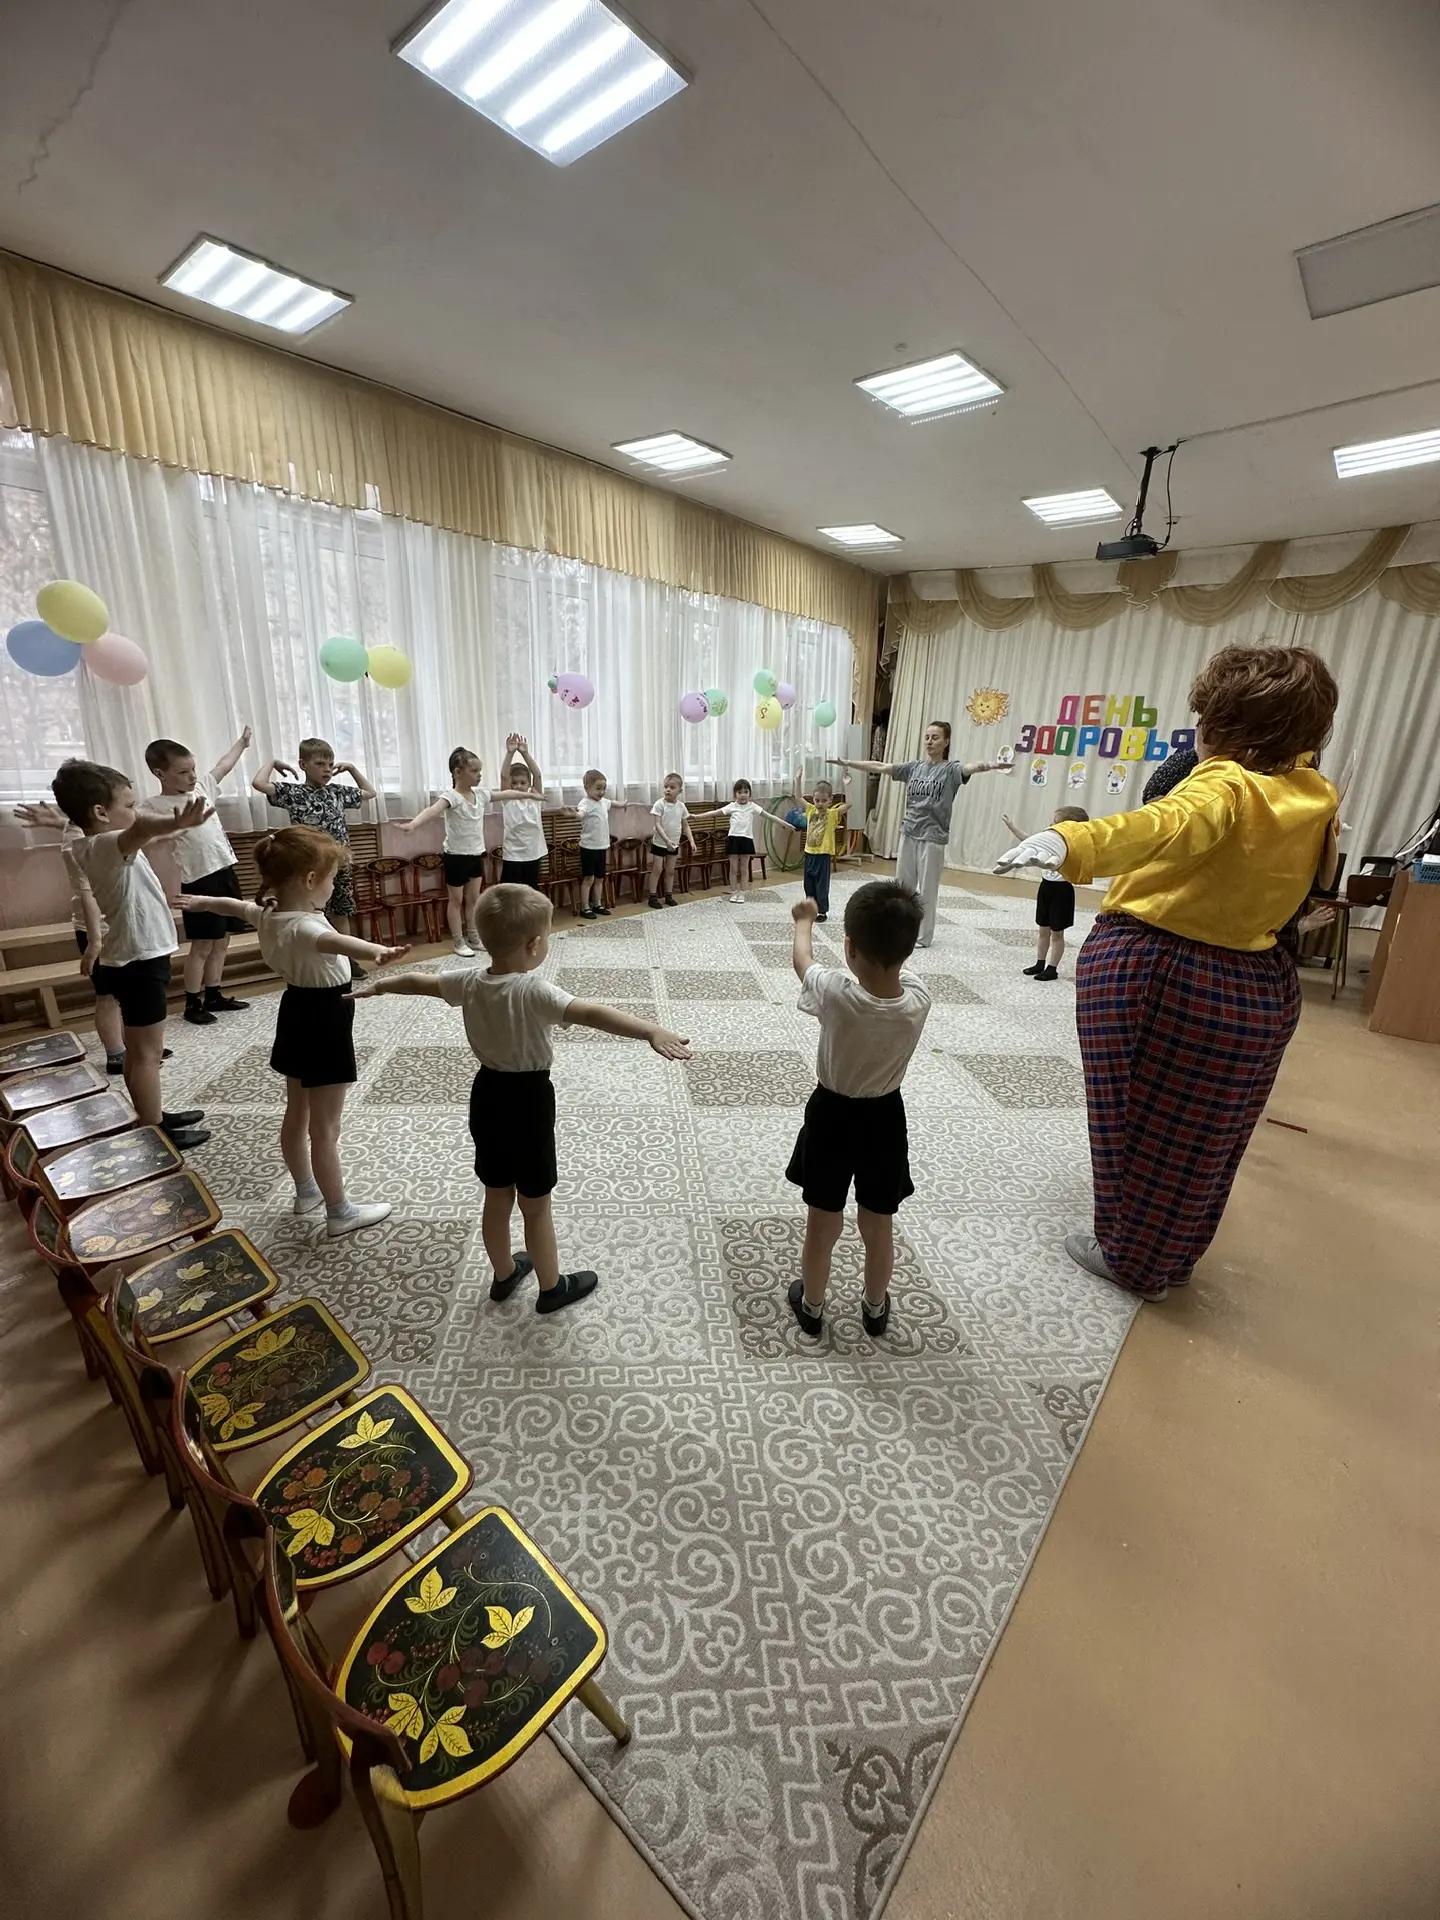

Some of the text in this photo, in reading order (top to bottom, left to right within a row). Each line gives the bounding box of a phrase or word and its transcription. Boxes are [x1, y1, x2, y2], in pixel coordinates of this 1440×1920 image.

[1056, 694, 1157, 727] ДЕНЬ
[1015, 725, 1195, 760] ЗДОРОВЬЯ
[907, 779, 944, 801] ROOKLYN
